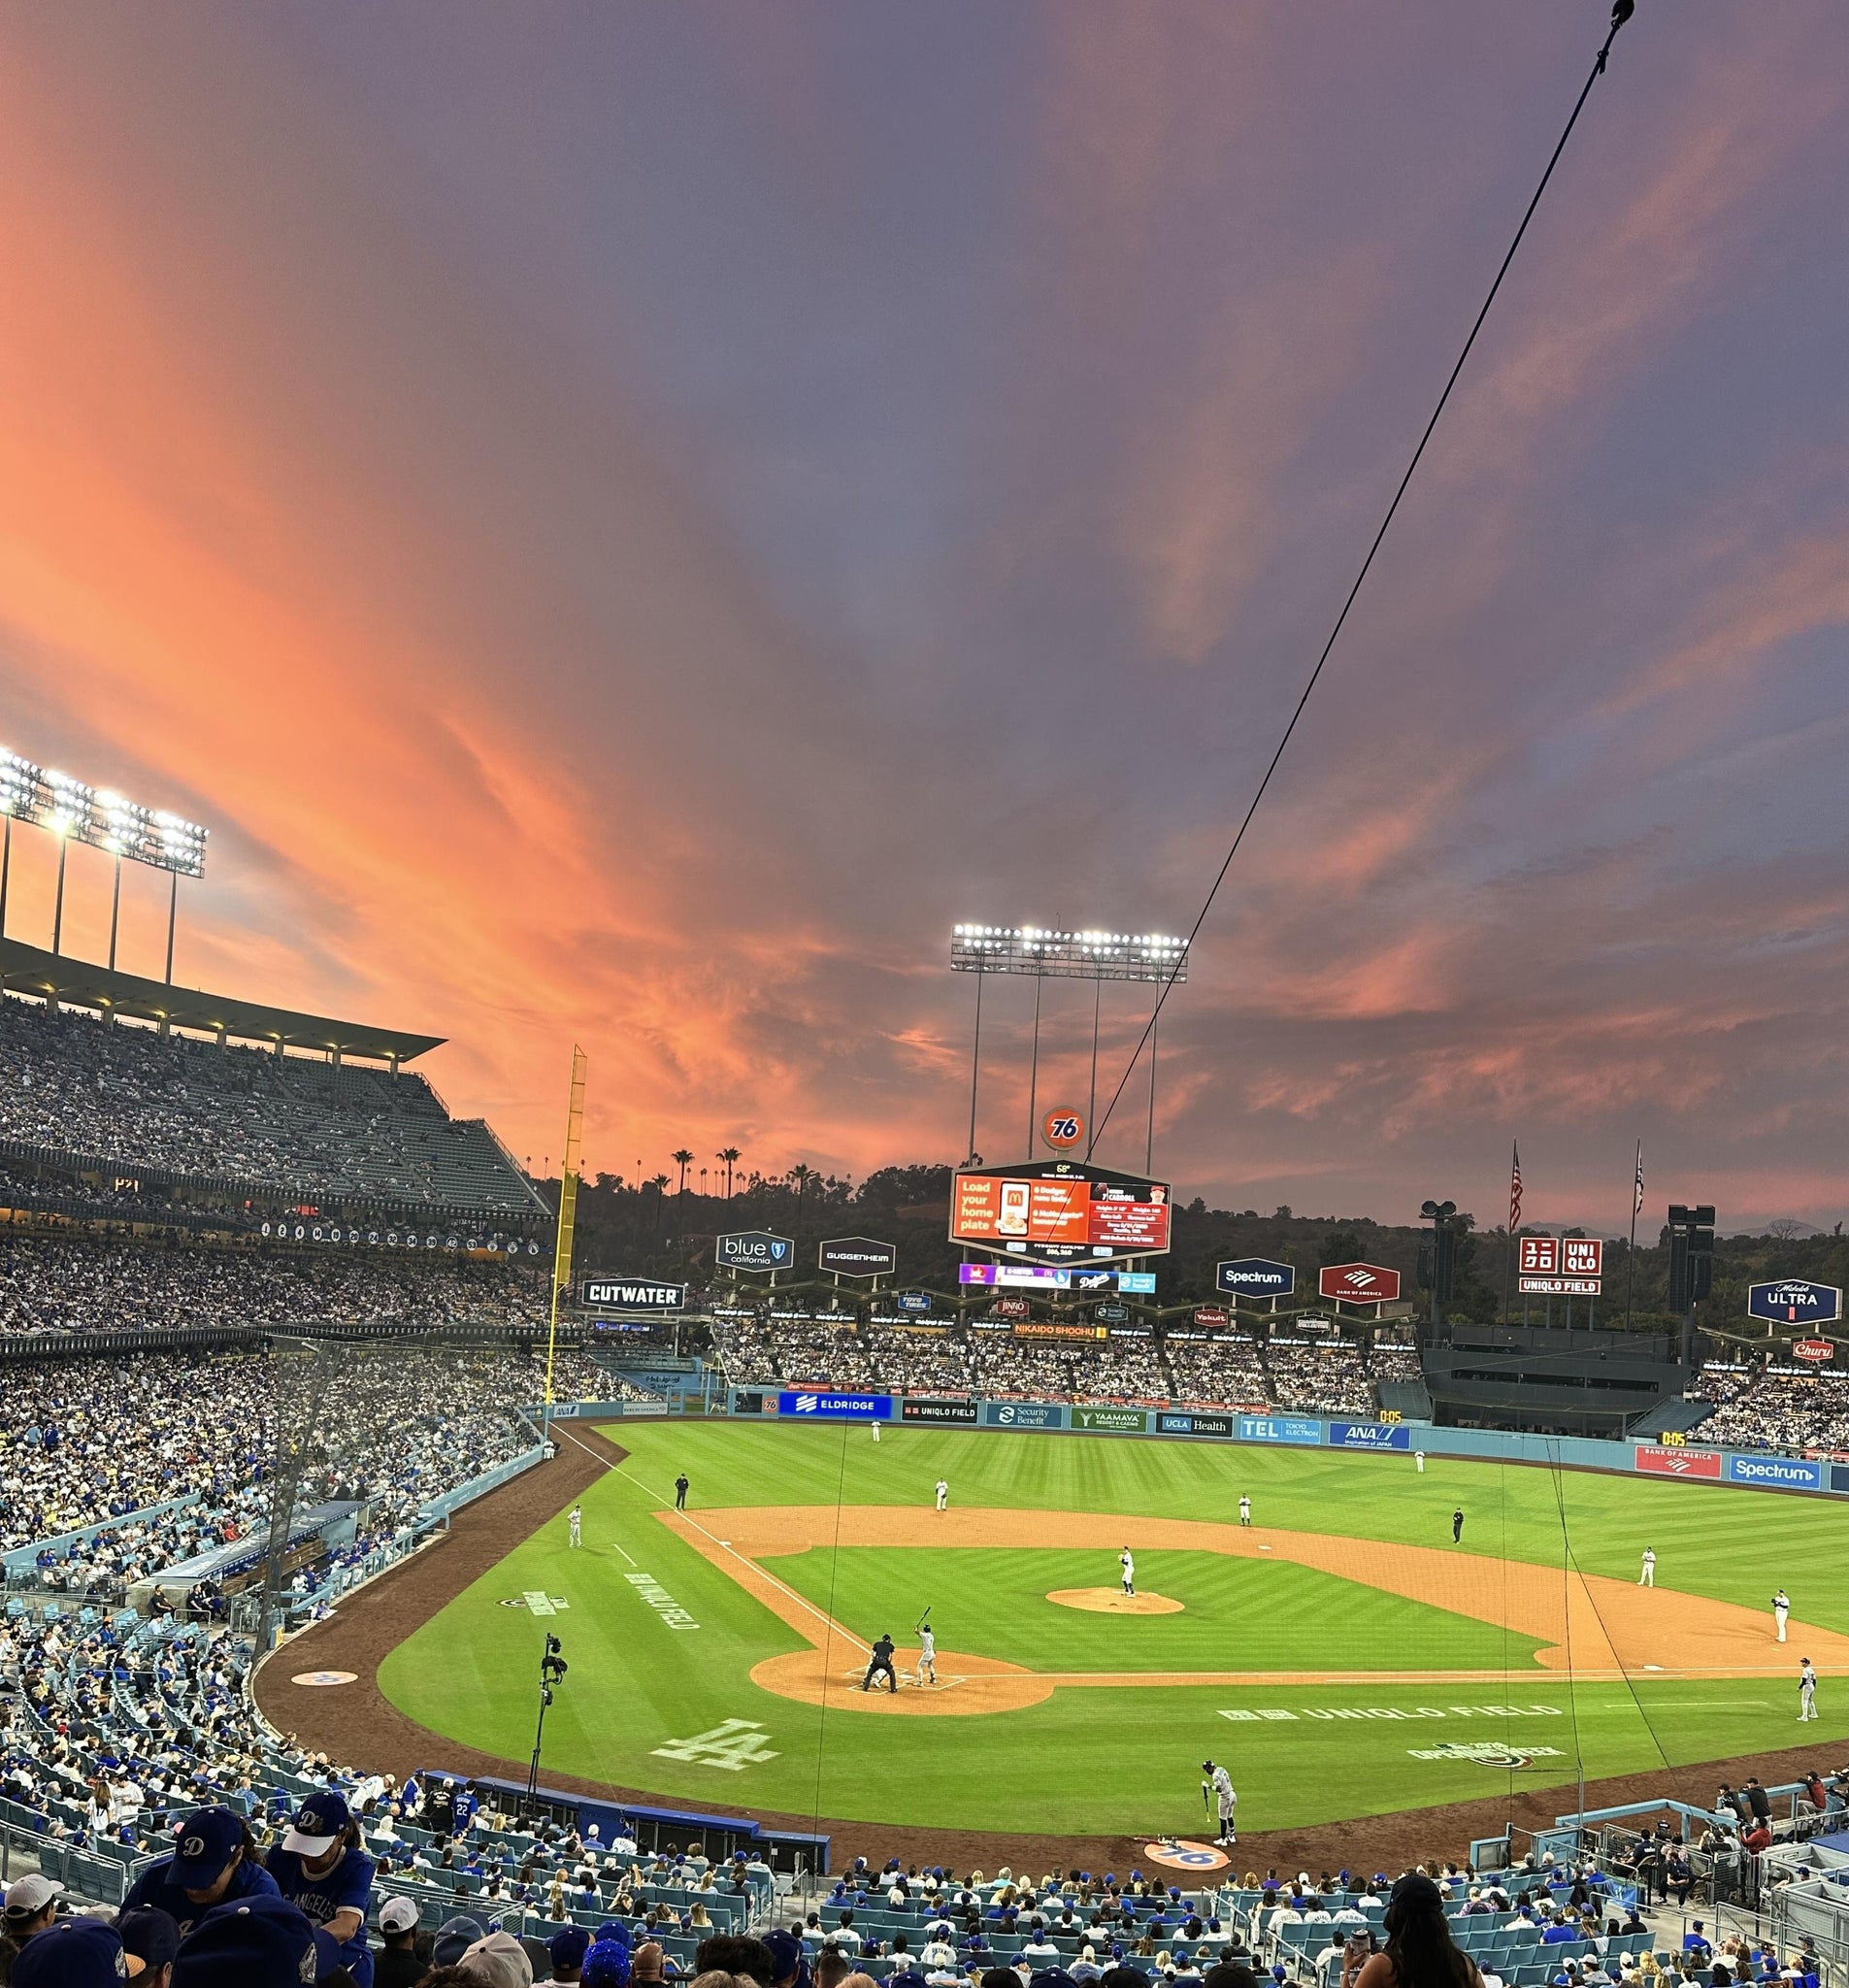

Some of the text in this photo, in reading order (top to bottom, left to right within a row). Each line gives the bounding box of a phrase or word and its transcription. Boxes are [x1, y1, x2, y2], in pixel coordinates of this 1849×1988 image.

[1051, 1117, 1078, 1139] 76
[962, 1182, 991, 1192] Load
[962, 1196, 988, 1206] your
[961, 1206, 994, 1217] home
[960, 1220, 990, 1231] plate
[725, 1238, 767, 1256] blue
[1568, 1243, 1595, 1257] UNI
[731, 1255, 771, 1265] california
[826, 1252, 889, 1263] GUGGENHEIM
[1567, 1257, 1597, 1271] QLO
[1079, 1273, 1110, 1288] Dodgers
[1225, 1270, 1282, 1284] Spectrum
[1523, 1280, 1596, 1292] UNIQLO FIELD
[589, 1285, 677, 1304] CUTWATER
[1767, 1293, 1818, 1305] ULTRA
[1002, 1302, 1025, 1311] JINRO
[1015, 1325, 1095, 1336] NIKAIDO SHOCHU
[1795, 1343, 1832, 1357] Churu
[764, 1400, 777, 1409] 76
[820, 1400, 875, 1410] ELDRIDGE
[921, 1407, 950, 1416] UNIQLO
[951, 1408, 975, 1417] FIELD
[1017, 1407, 1049, 1418] Security
[1379, 1409, 1402, 1423] 0:05
[1017, 1415, 1044, 1425] Benefit
[1166, 1419, 1227, 1432] UCLA Health
[1243, 1420, 1279, 1438] TEL
[1345, 1426, 1376, 1440] ANA
[1662, 1432, 1686, 1447] 0:05
[1678, 1451, 1712, 1461] AMERICA
[1735, 1460, 1808, 1481] Spectrum
[635, 1585, 701, 1630] UNIQLO FIELD
[1301, 1707, 1447, 1719] UNIQLO
[1448, 1706, 1564, 1717] FIELD
[1405, 1746, 1568, 1760] OPENING WEEK
[456, 1804, 468, 1816] 22
[297, 1809, 317, 1829] D
[182, 1837, 205, 1857] D
[1156, 1844, 1215, 1865] 76
